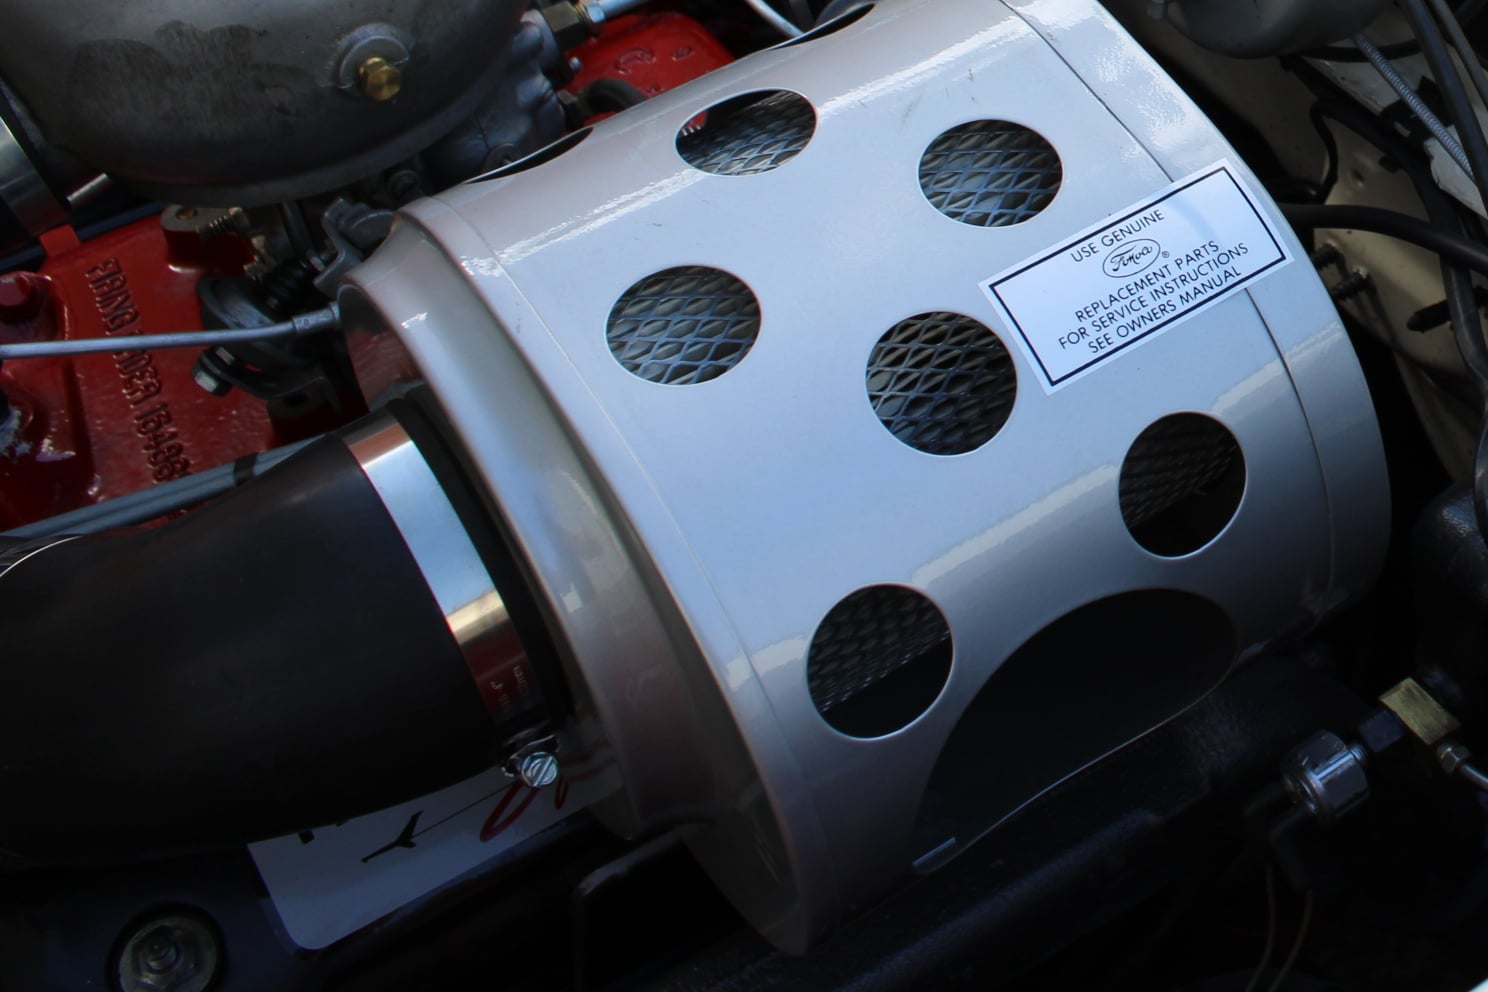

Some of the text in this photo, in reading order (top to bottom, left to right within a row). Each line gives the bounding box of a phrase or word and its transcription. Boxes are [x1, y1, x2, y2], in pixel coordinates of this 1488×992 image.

[1070, 208, 1165, 263] USE GENUINE
[1058, 242, 1249, 350] FOR SERVICE INSTRUCTIONS
[1074, 240, 1220, 323] REPLACEMENT PARTS
[1087, 266, 1242, 354] SEE OWNERS MANUAL
[84, 256, 140, 336] FIRING
[112, 330, 163, 408] RDER
